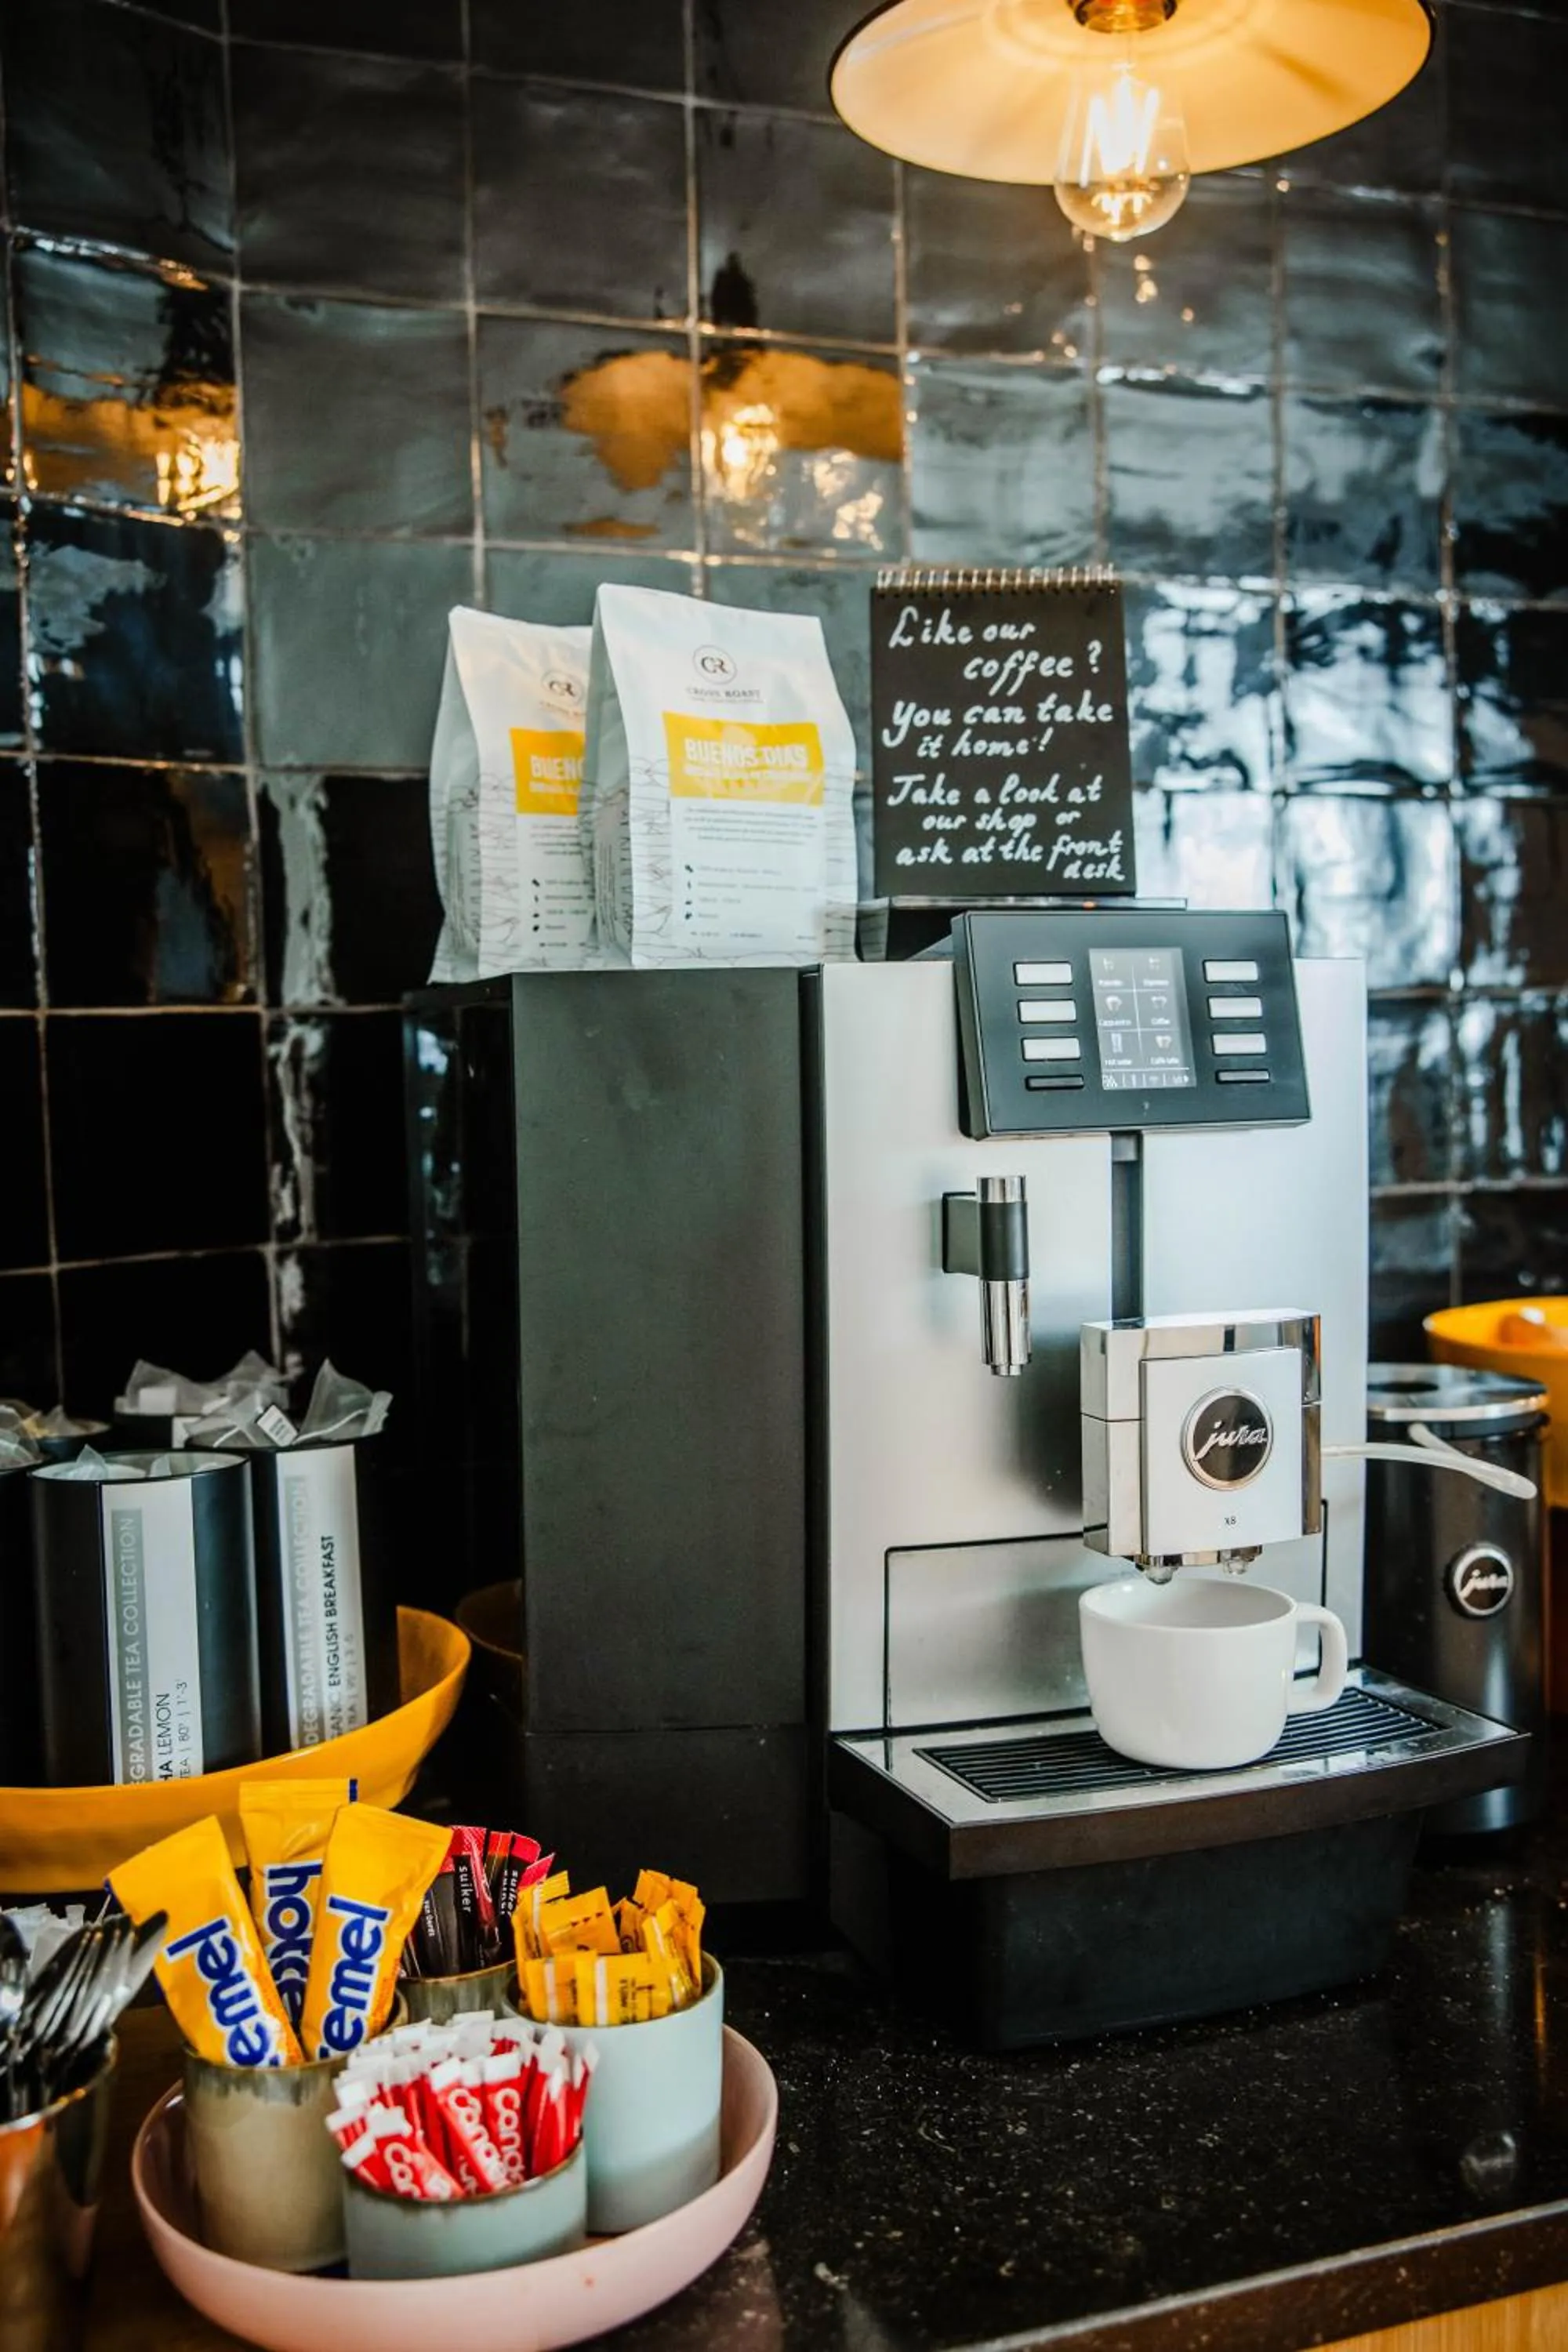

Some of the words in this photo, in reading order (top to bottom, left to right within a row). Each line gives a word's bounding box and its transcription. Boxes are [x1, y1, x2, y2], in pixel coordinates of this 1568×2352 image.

[888, 605, 973, 648] Like
[982, 622, 1036, 641] our
[700, 655, 728, 674] CR
[963, 706, 1026, 725] can
[1036, 690, 1114, 723] take
[684, 737, 754, 768] BUENOS
[916, 735, 943, 758] it
[887, 773, 960, 807] Take
[974, 788, 991, 804] a
[999, 773, 1060, 804] look
[1068, 775, 1103, 803] at
[922, 813, 967, 831] our
[975, 808, 1038, 838] shop
[1055, 811, 1082, 826] or
[895, 838, 953, 866] ask
[961, 837, 995, 863] at
[999, 833, 1044, 862] the
[1047, 830, 1123, 871] front
[1063, 855, 1125, 880] desk
[1193, 1420, 1268, 1461] jura
[119, 1518, 139, 1635] COLLECTION
[321, 1535, 337, 1617] BREAKFAST
[125, 1642, 142, 1674] TEA
[325, 1622, 341, 1686] ENGLISH
[156, 1693, 172, 1755] LEMON
[459, 1865, 474, 1913] suiker
